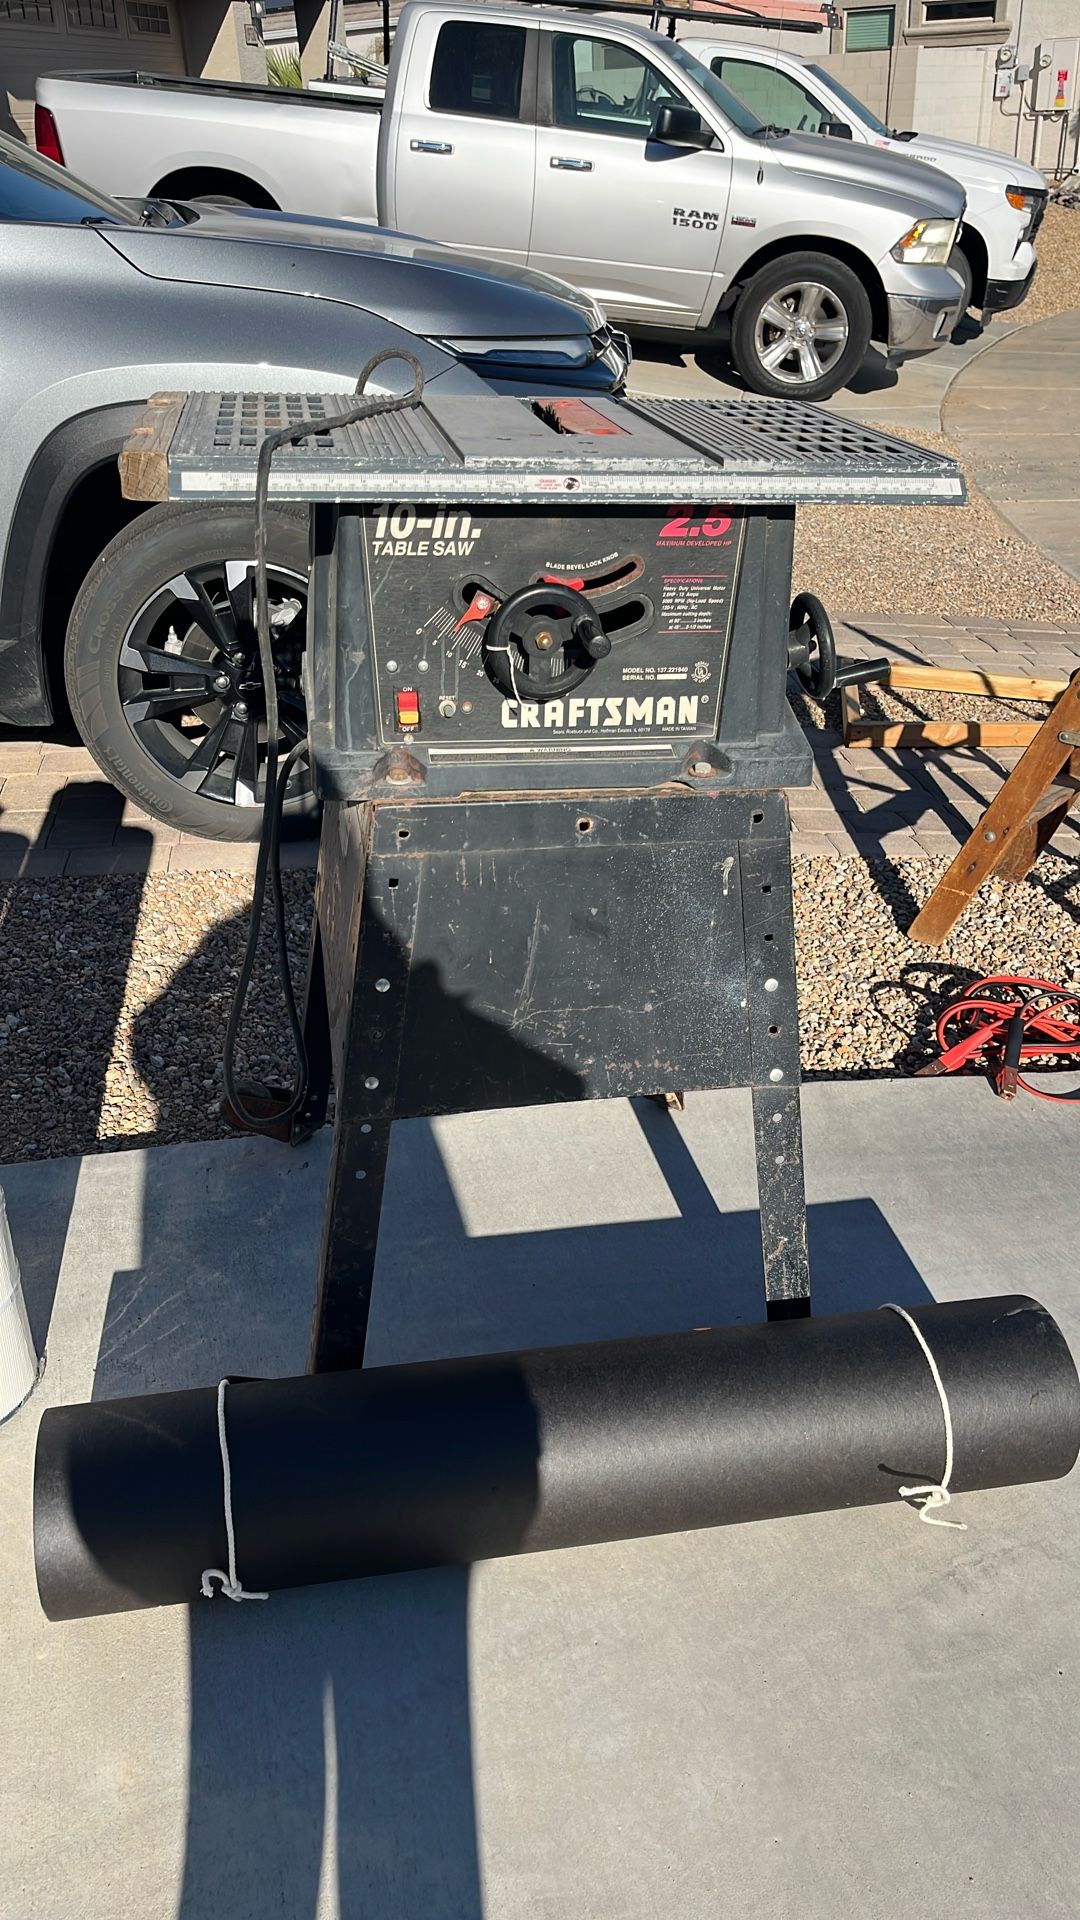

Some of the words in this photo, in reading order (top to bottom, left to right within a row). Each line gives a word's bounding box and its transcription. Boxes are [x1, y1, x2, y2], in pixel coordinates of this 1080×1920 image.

[673, 207, 720, 221] RAM
[672, 218, 718, 231] 1500
[372, 503, 482, 540] 10-in.
[658, 504, 736, 537] 2.5
[372, 541, 430, 556] TABLE
[432, 541, 475, 557] SAW
[545, 561, 565, 570] BLADE
[586, 559, 602, 569] LOCK
[602, 551, 619, 563] KNOB
[501, 696, 699, 728] CRAFTSMAN
